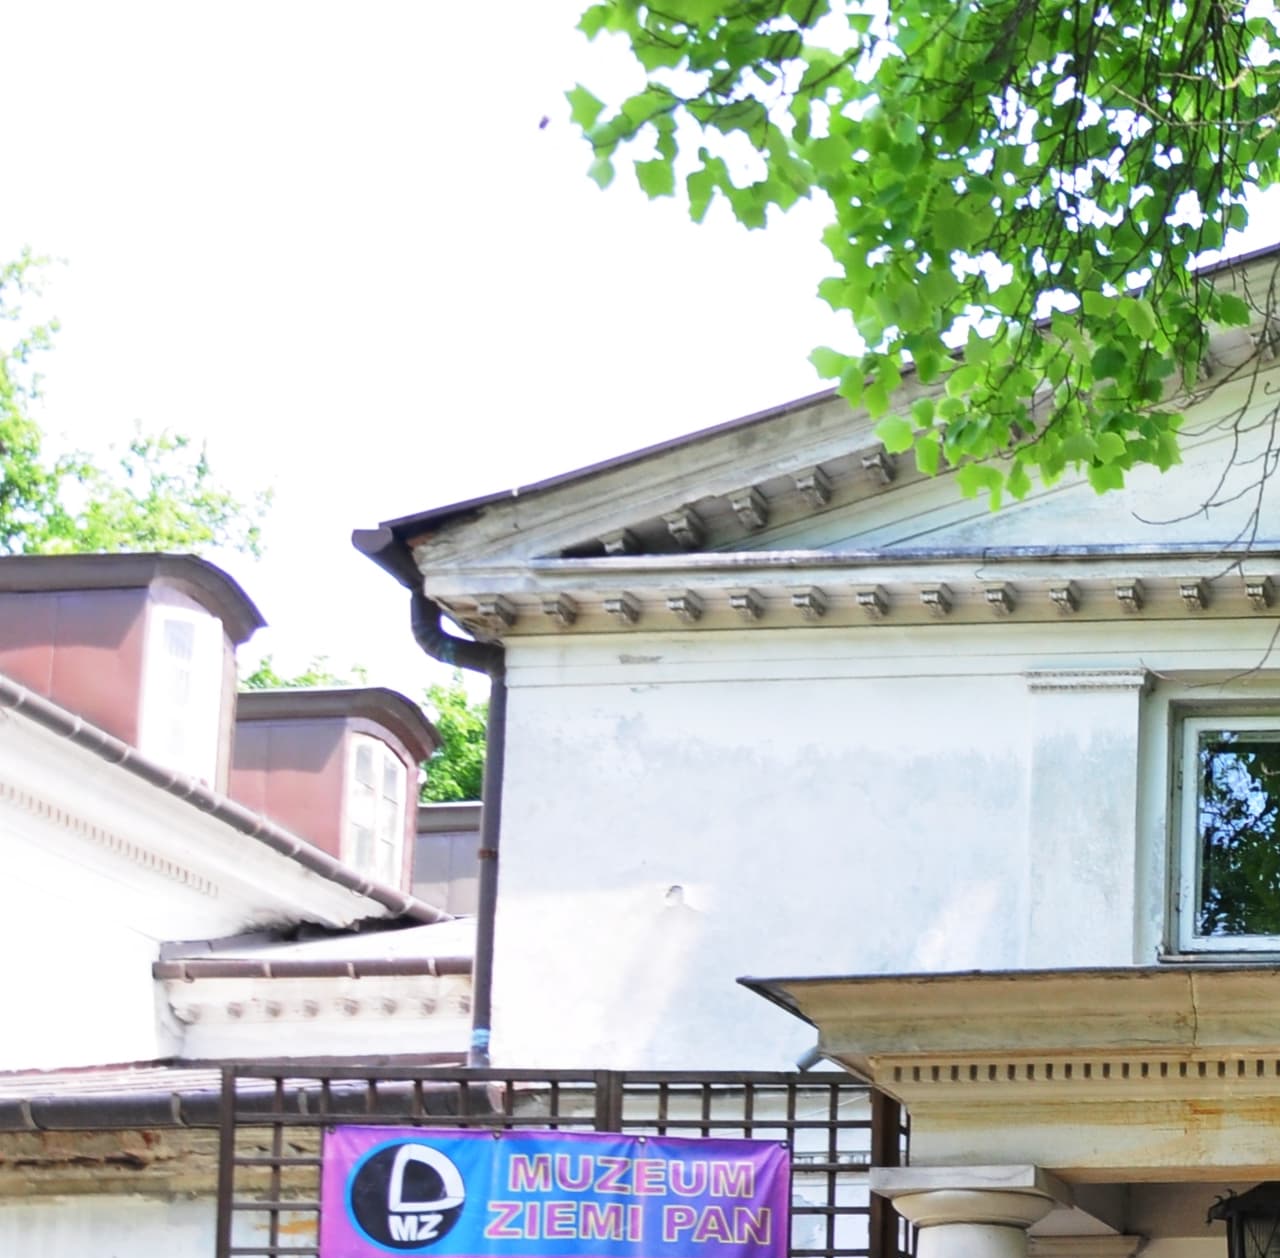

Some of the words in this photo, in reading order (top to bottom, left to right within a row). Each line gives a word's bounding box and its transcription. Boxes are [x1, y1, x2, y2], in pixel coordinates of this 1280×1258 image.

[508, 1153, 754, 1198] MUZEUM
[388, 1213, 444, 1241] MZ
[484, 1201, 643, 1242] ZIEMI
[663, 1205, 771, 1245] PAN
